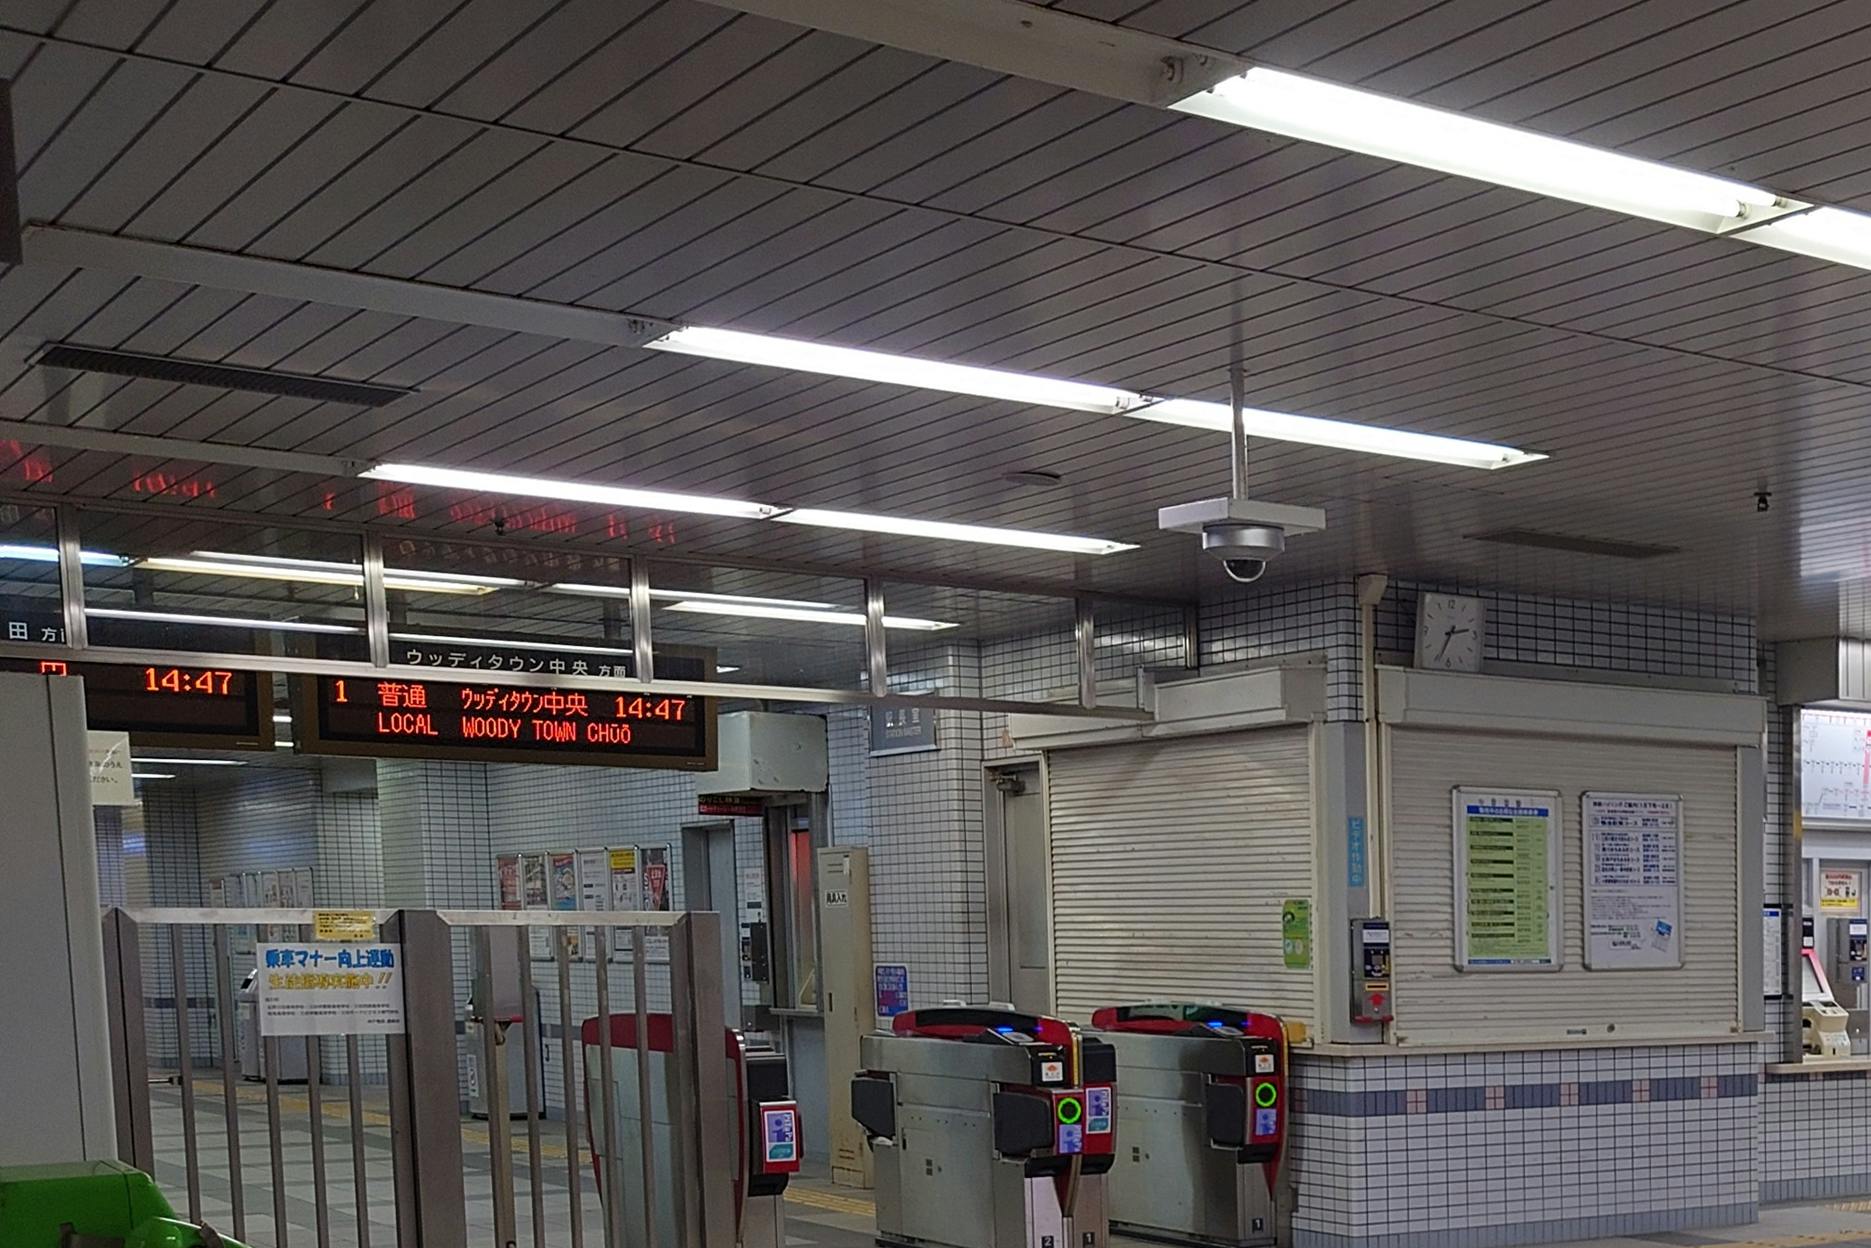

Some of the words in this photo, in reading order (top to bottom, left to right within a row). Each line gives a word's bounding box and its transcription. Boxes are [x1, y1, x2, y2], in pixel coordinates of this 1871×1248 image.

[41, 627, 65, 643] 方
[406, 648, 589, 677] ウッディタウン中央
[599, 664, 628, 679] 方面
[145, 667, 233, 695] 14:47
[335, 680, 348, 703] 1
[377, 681, 428, 709] 普通
[614, 695, 686, 721] 14:47
[377, 711, 439, 736] LOCAL
[461, 715, 521, 739] WOODY
[532, 719, 577, 742] TOWN
[265, 948, 395, 969] 乗車マナー向上運動
[1044, 1236, 1052, 1247] 2
